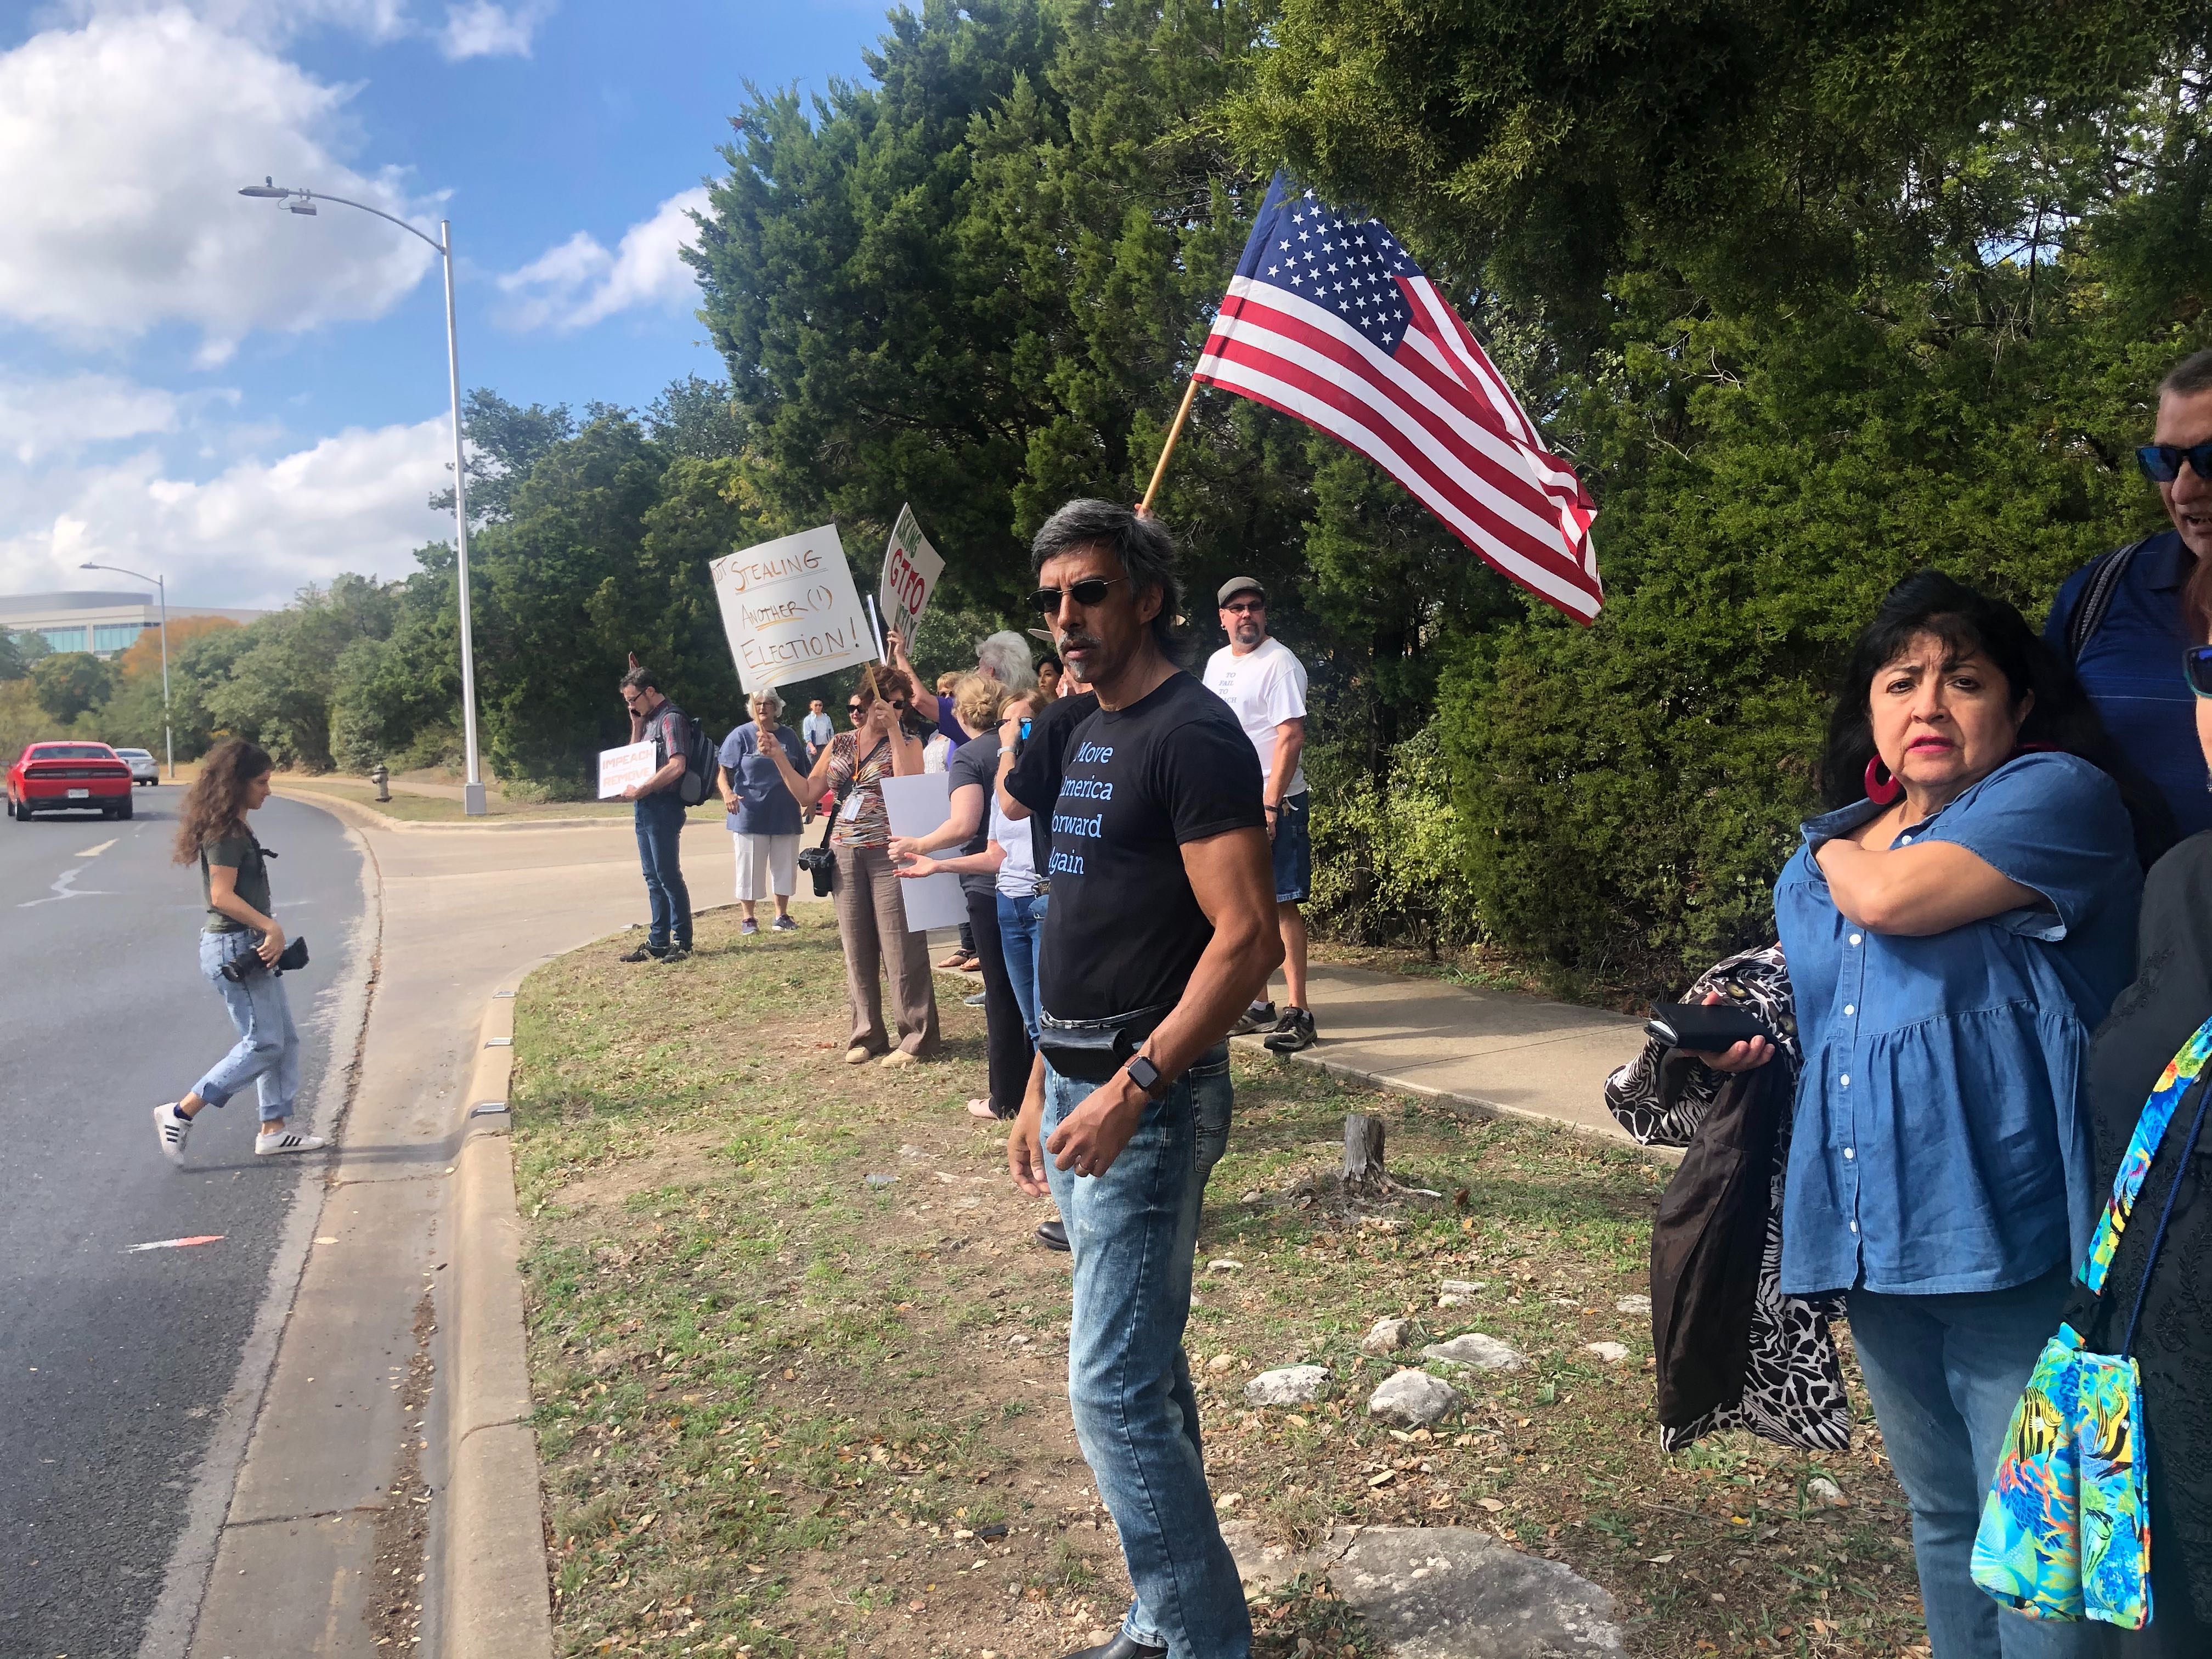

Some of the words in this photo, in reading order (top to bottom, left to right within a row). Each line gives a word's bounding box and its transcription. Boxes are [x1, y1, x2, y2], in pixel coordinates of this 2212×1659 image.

[731, 550, 822, 591] STEALING
[890, 548, 925, 615] GTFO
[742, 601, 808, 630] ANOTHER
[602, 748, 653, 770] IMPEACH
[603, 767, 651, 787] REMOVE
[1052, 810, 1103, 838] orward
